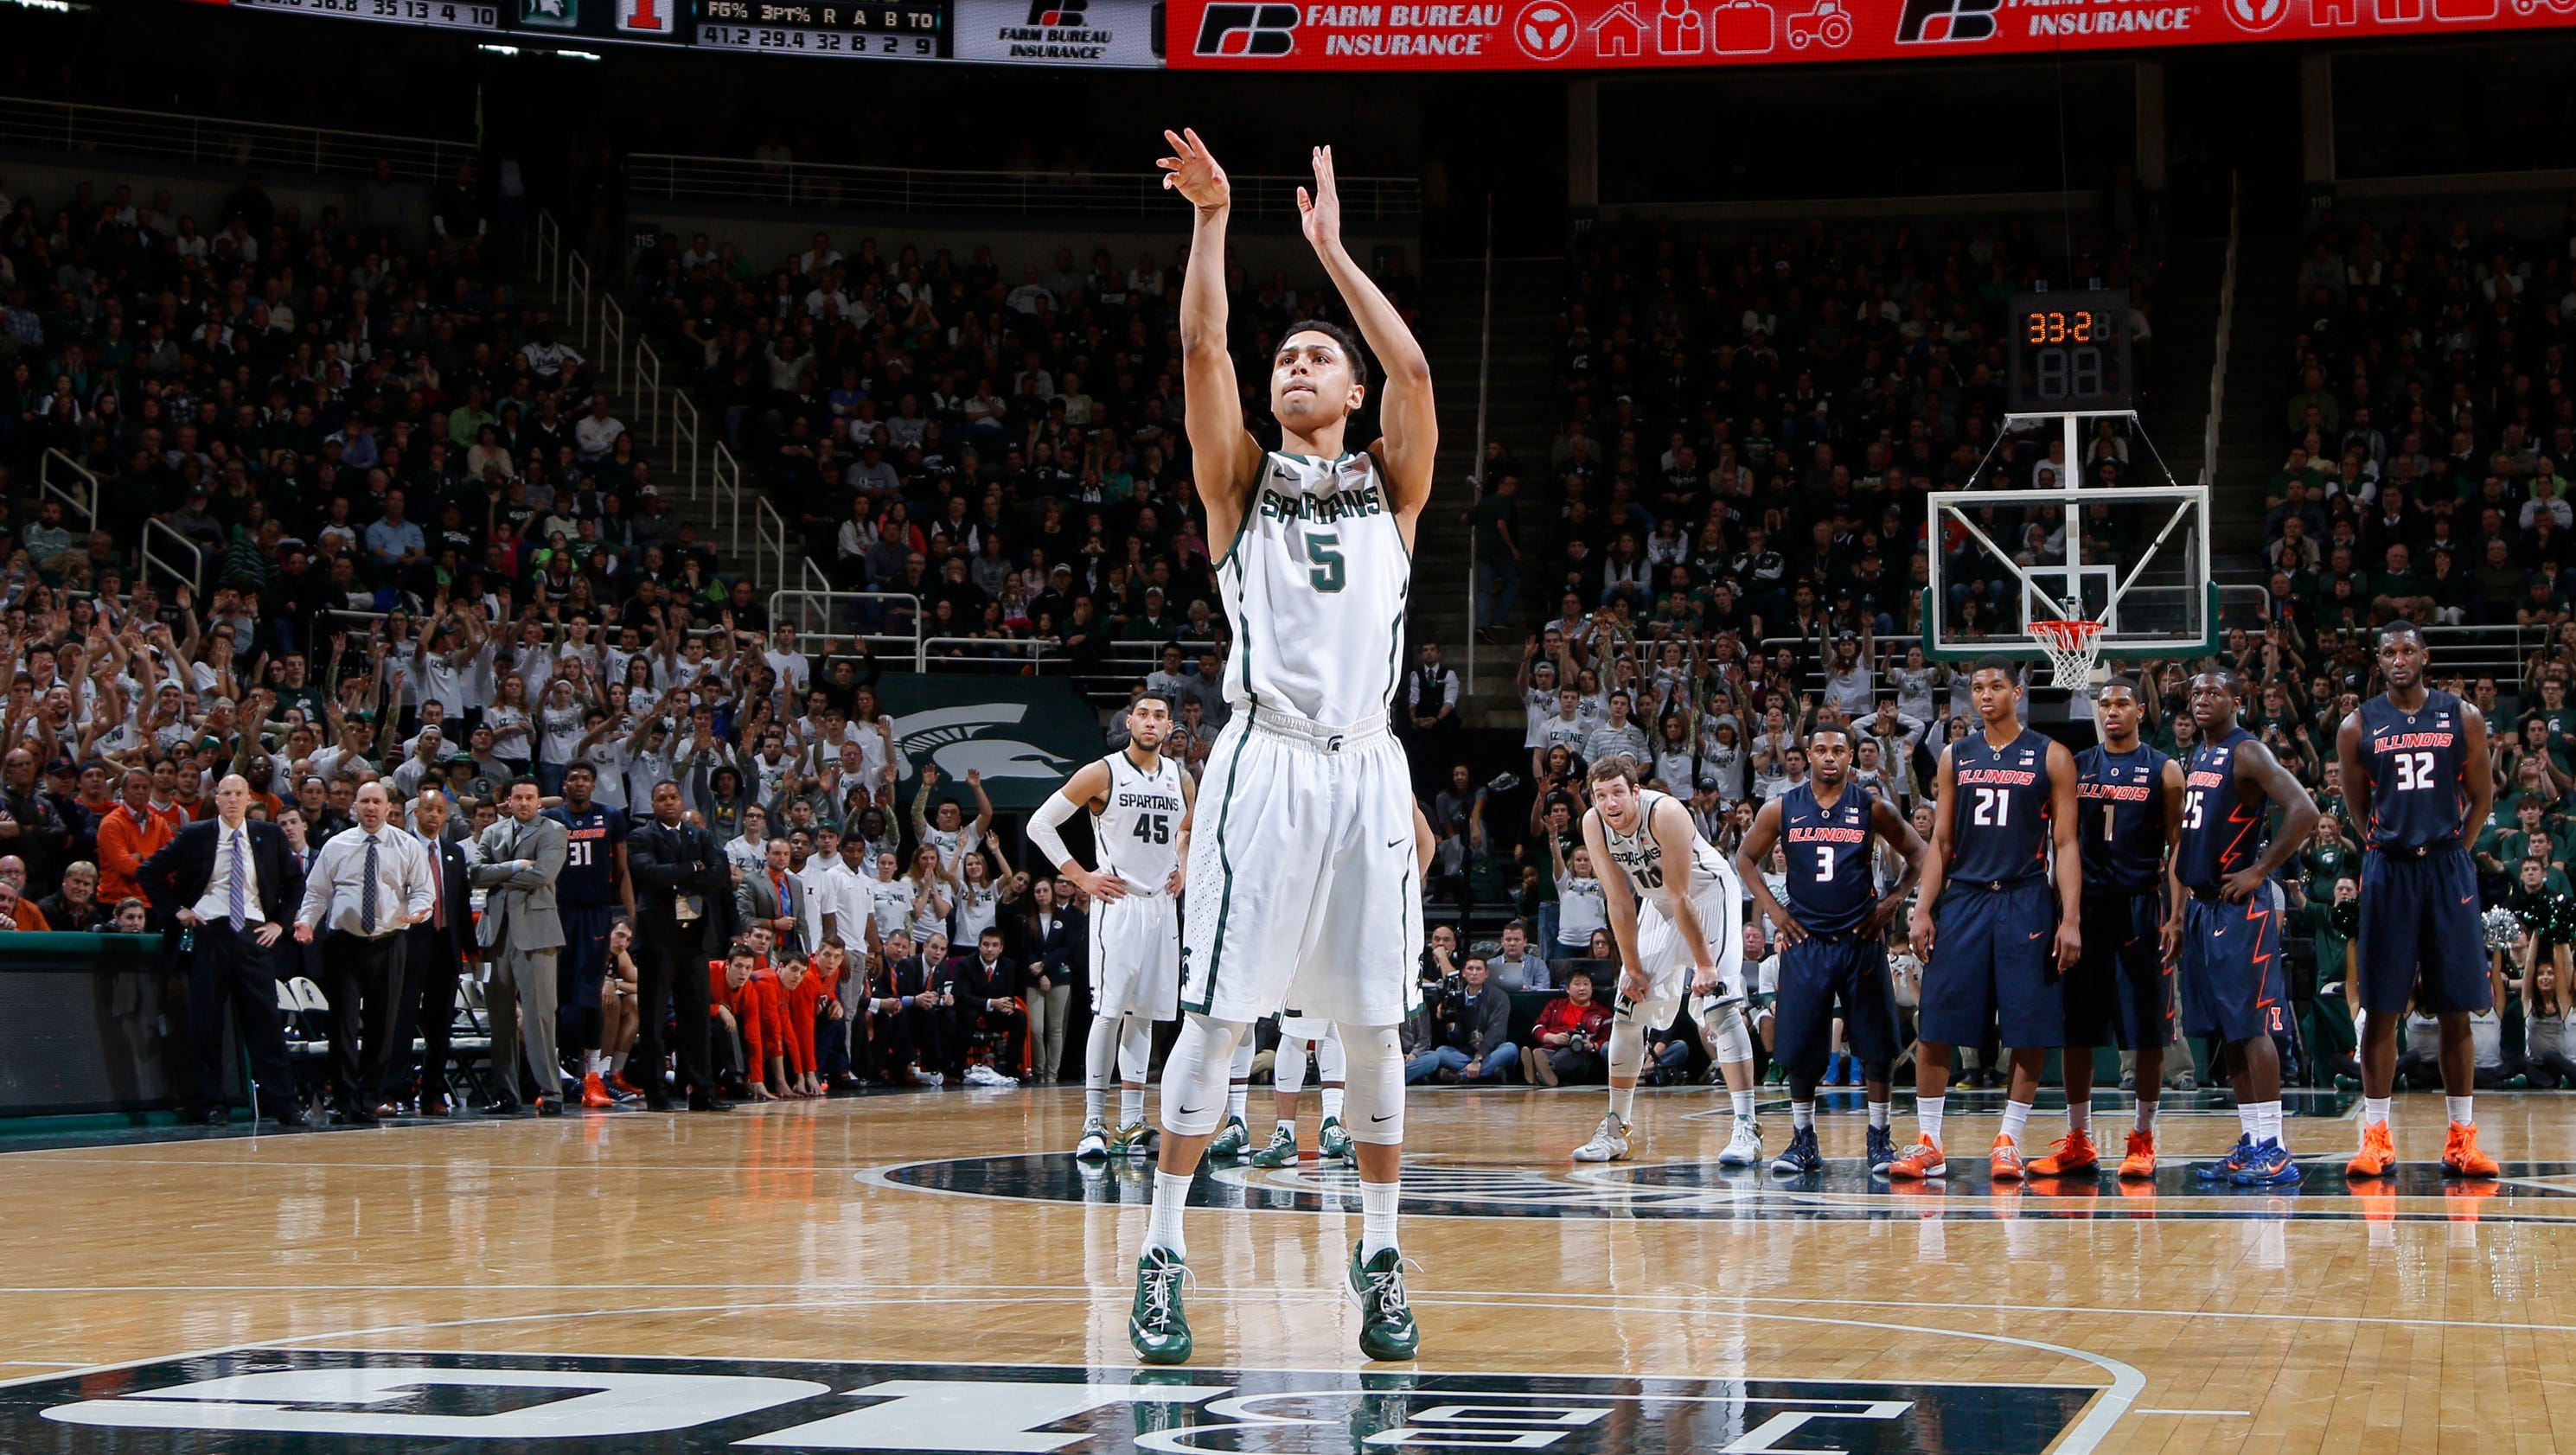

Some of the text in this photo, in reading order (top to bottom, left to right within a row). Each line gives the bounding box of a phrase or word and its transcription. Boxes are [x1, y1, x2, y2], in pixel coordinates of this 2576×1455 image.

[406, 1, 429, 18] 13
[442, 4, 456, 21] 4
[471, 7, 494, 25] 10
[708, 1, 933, 28] FG% 3PT% R A B TO
[1305, 4, 1503, 27] FARM BUREAU
[2029, 7, 2193, 36] INSURANCE
[705, 26, 930, 54] 41.2 29.4 32 8 2 9
[999, 27, 1113, 43] FARM BUREAU
[1325, 34, 1484, 55] INSURANCE
[1010, 44, 1102, 59] INSURANCE
[635, 233, 658, 248] 115
[2029, 311, 2091, 342] 33.2
[1261, 485, 1380, 525] SPARTANS
[1305, 531, 1346, 593] 5
[2374, 732, 2454, 754] ILLINOIS
[1958, 769, 2036, 786] ILLINOIS
[2394, 751, 2434, 790] 32
[1119, 793, 1179, 812] SPARTANS
[2076, 782, 2151, 801] ILLINOIS
[1974, 788, 2010, 826] 21
[2182, 790, 2204, 829] 25
[1133, 813, 1170, 846] 45
[2103, 804, 2115, 841] 1
[1788, 827, 1865, 844] ILLINOIS
[569, 840, 591, 865] 31
[1816, 846, 1834, 882] 3
[1632, 865, 1663, 889] 10
